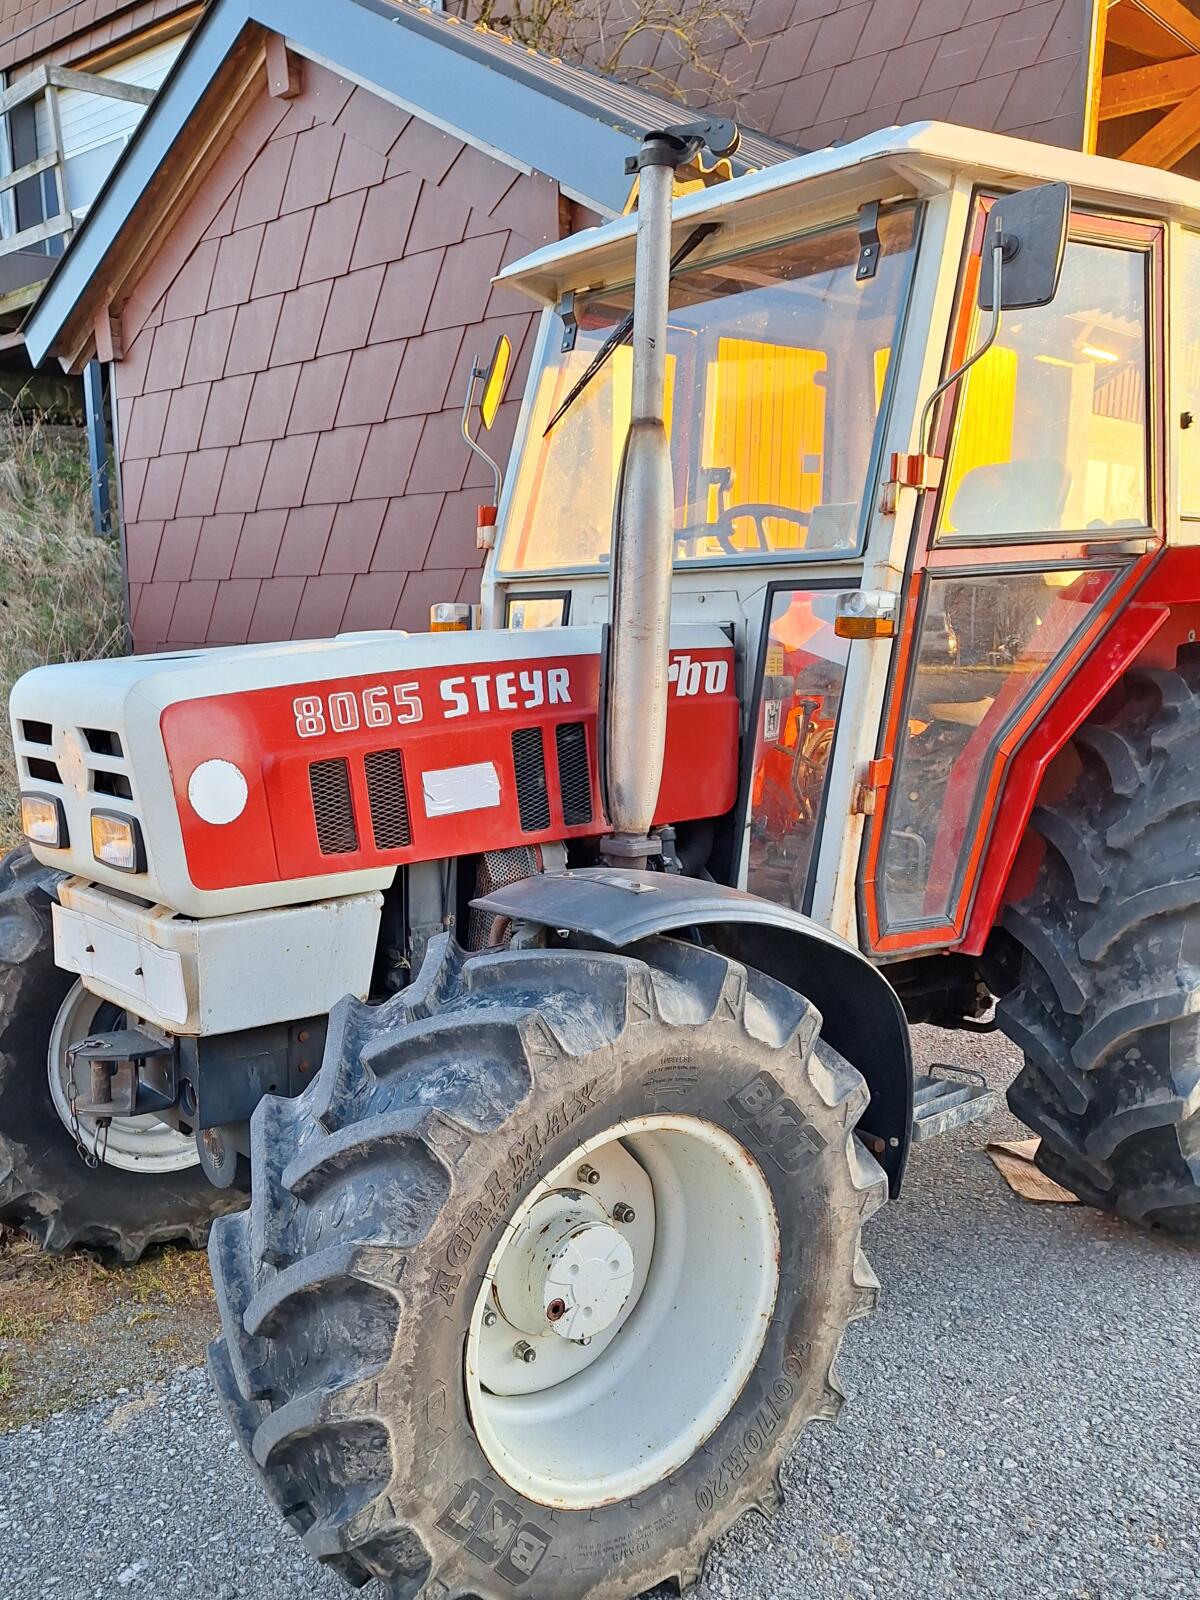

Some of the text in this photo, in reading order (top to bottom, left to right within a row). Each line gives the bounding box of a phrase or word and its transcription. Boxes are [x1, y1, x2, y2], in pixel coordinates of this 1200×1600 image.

[293, 681, 424, 738] 8065
[440, 667, 572, 719] STEYR
[731, 1074, 823, 1166] BKT
[432, 1078, 598, 1307] AGRIMAX
[442, 1487, 550, 1580] BKT
